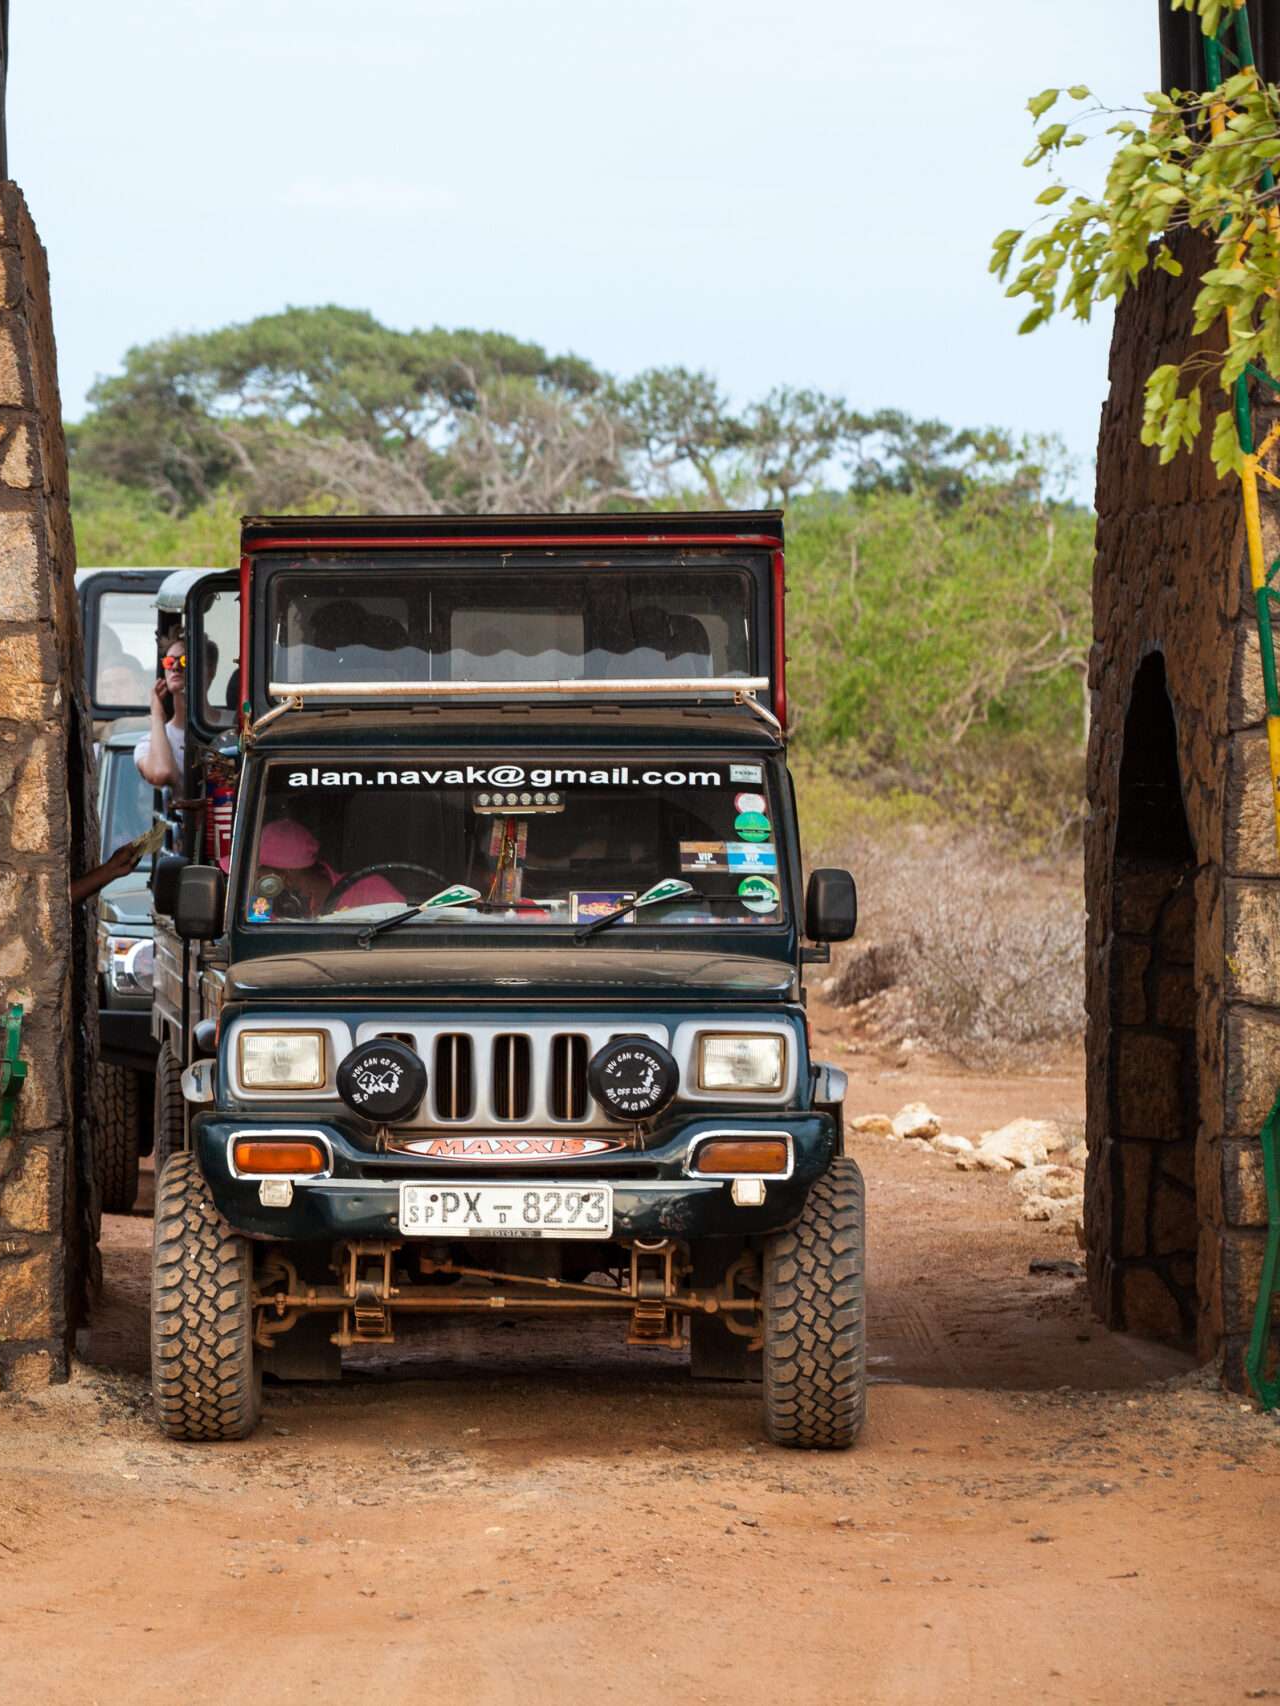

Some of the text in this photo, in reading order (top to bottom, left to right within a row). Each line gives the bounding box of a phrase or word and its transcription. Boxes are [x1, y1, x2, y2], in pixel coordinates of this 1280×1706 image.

[287, 765, 721, 788] alan.navak@gmail.com
[363, 1057, 378, 1067] CAN
[617, 1052, 632, 1063] CAN
[426, 1138, 585, 1155] MAXXIS
